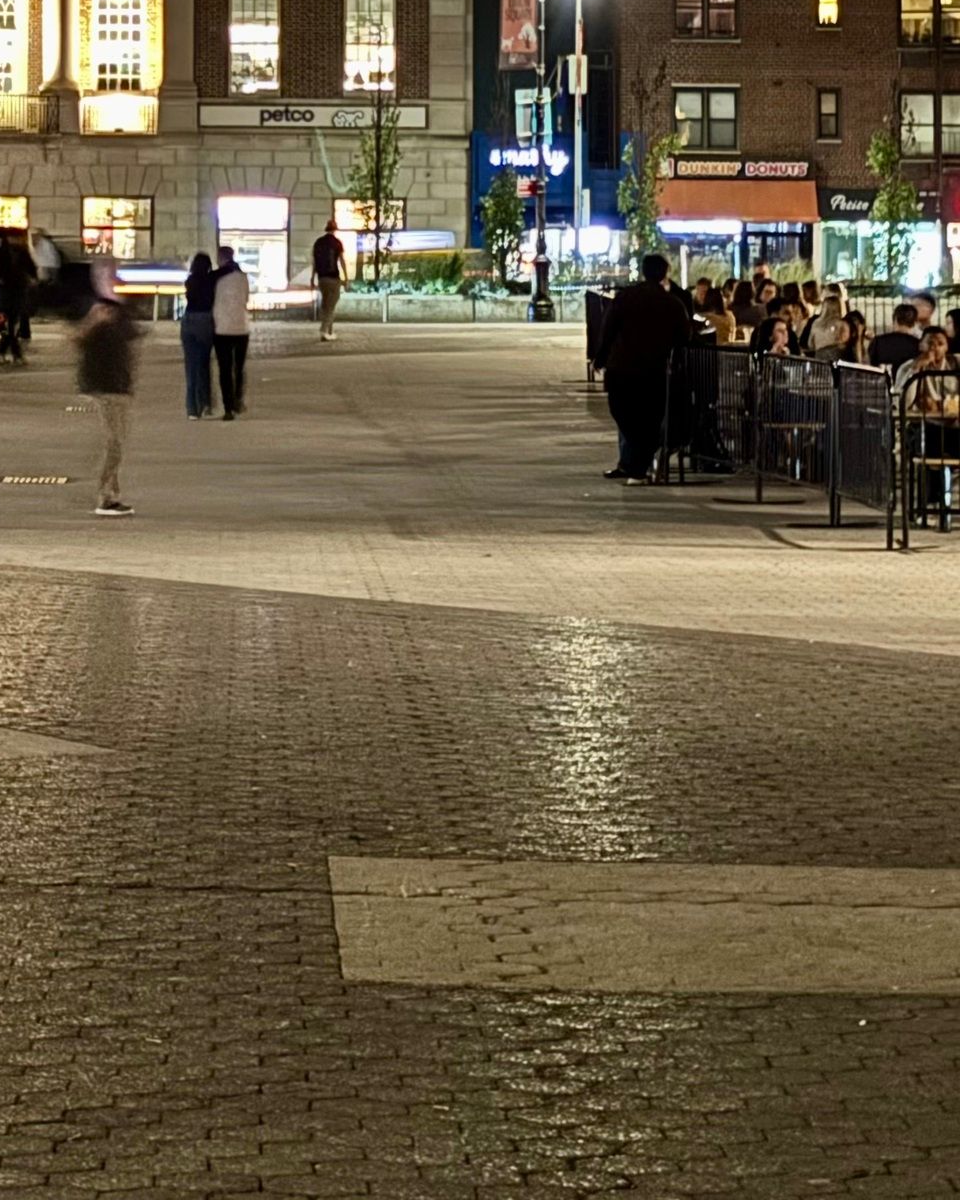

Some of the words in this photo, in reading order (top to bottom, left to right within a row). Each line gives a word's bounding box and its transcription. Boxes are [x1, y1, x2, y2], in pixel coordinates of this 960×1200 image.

[260, 104, 315, 127] petco
[677, 161, 742, 176] DUNKIN'
[745, 162, 808, 176] DONUTS
